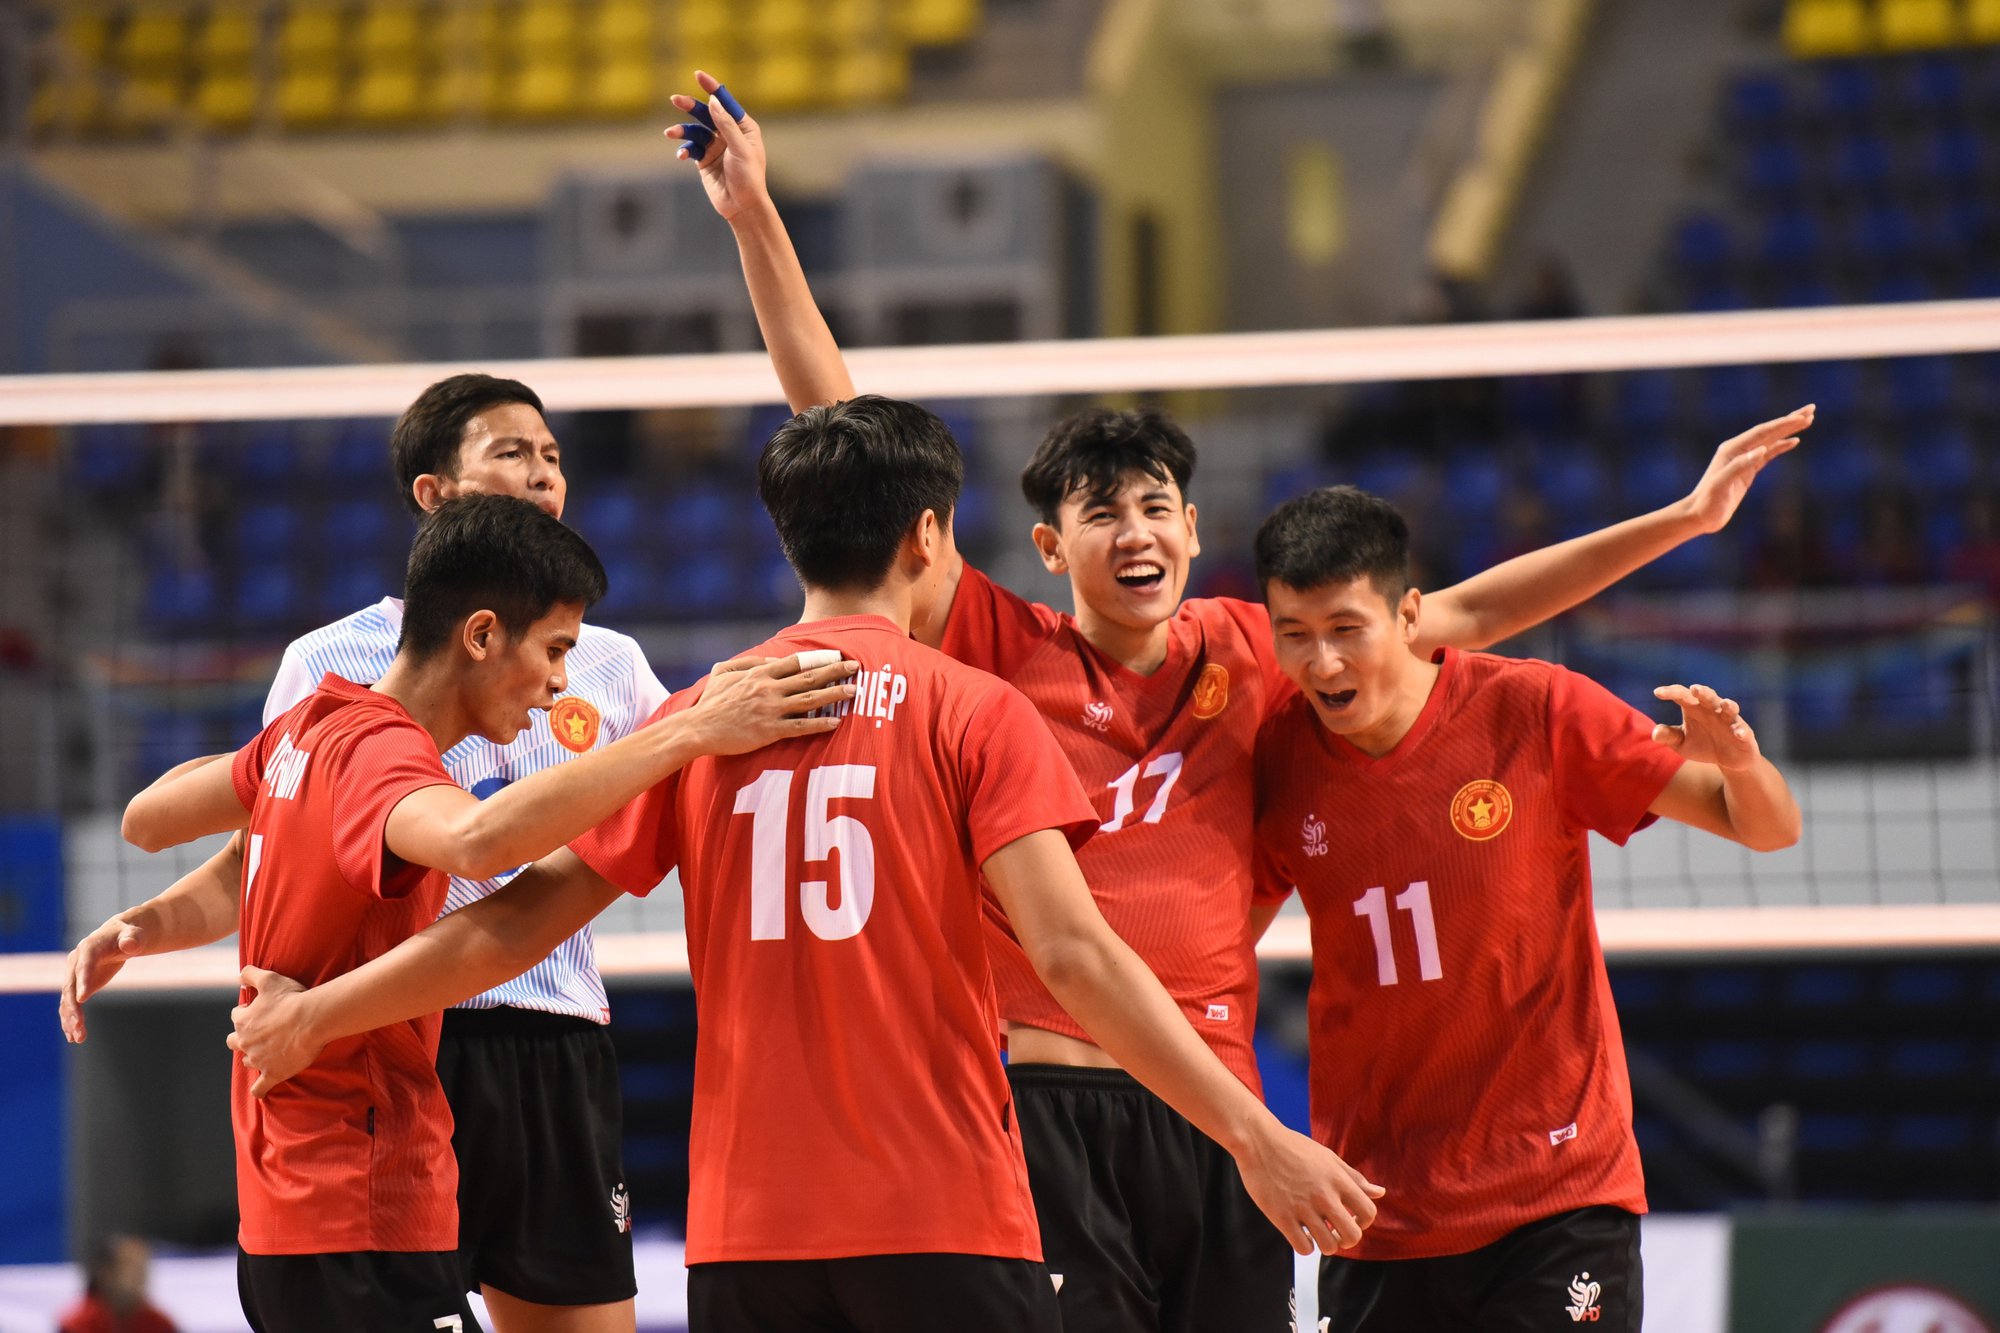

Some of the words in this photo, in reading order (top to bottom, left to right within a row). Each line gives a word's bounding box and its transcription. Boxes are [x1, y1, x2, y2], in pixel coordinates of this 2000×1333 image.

[1100, 752, 1184, 832] 17
[733, 764, 876, 941] 15
[1353, 881, 1443, 986] 11
[1565, 1304, 1601, 1321] VHD
